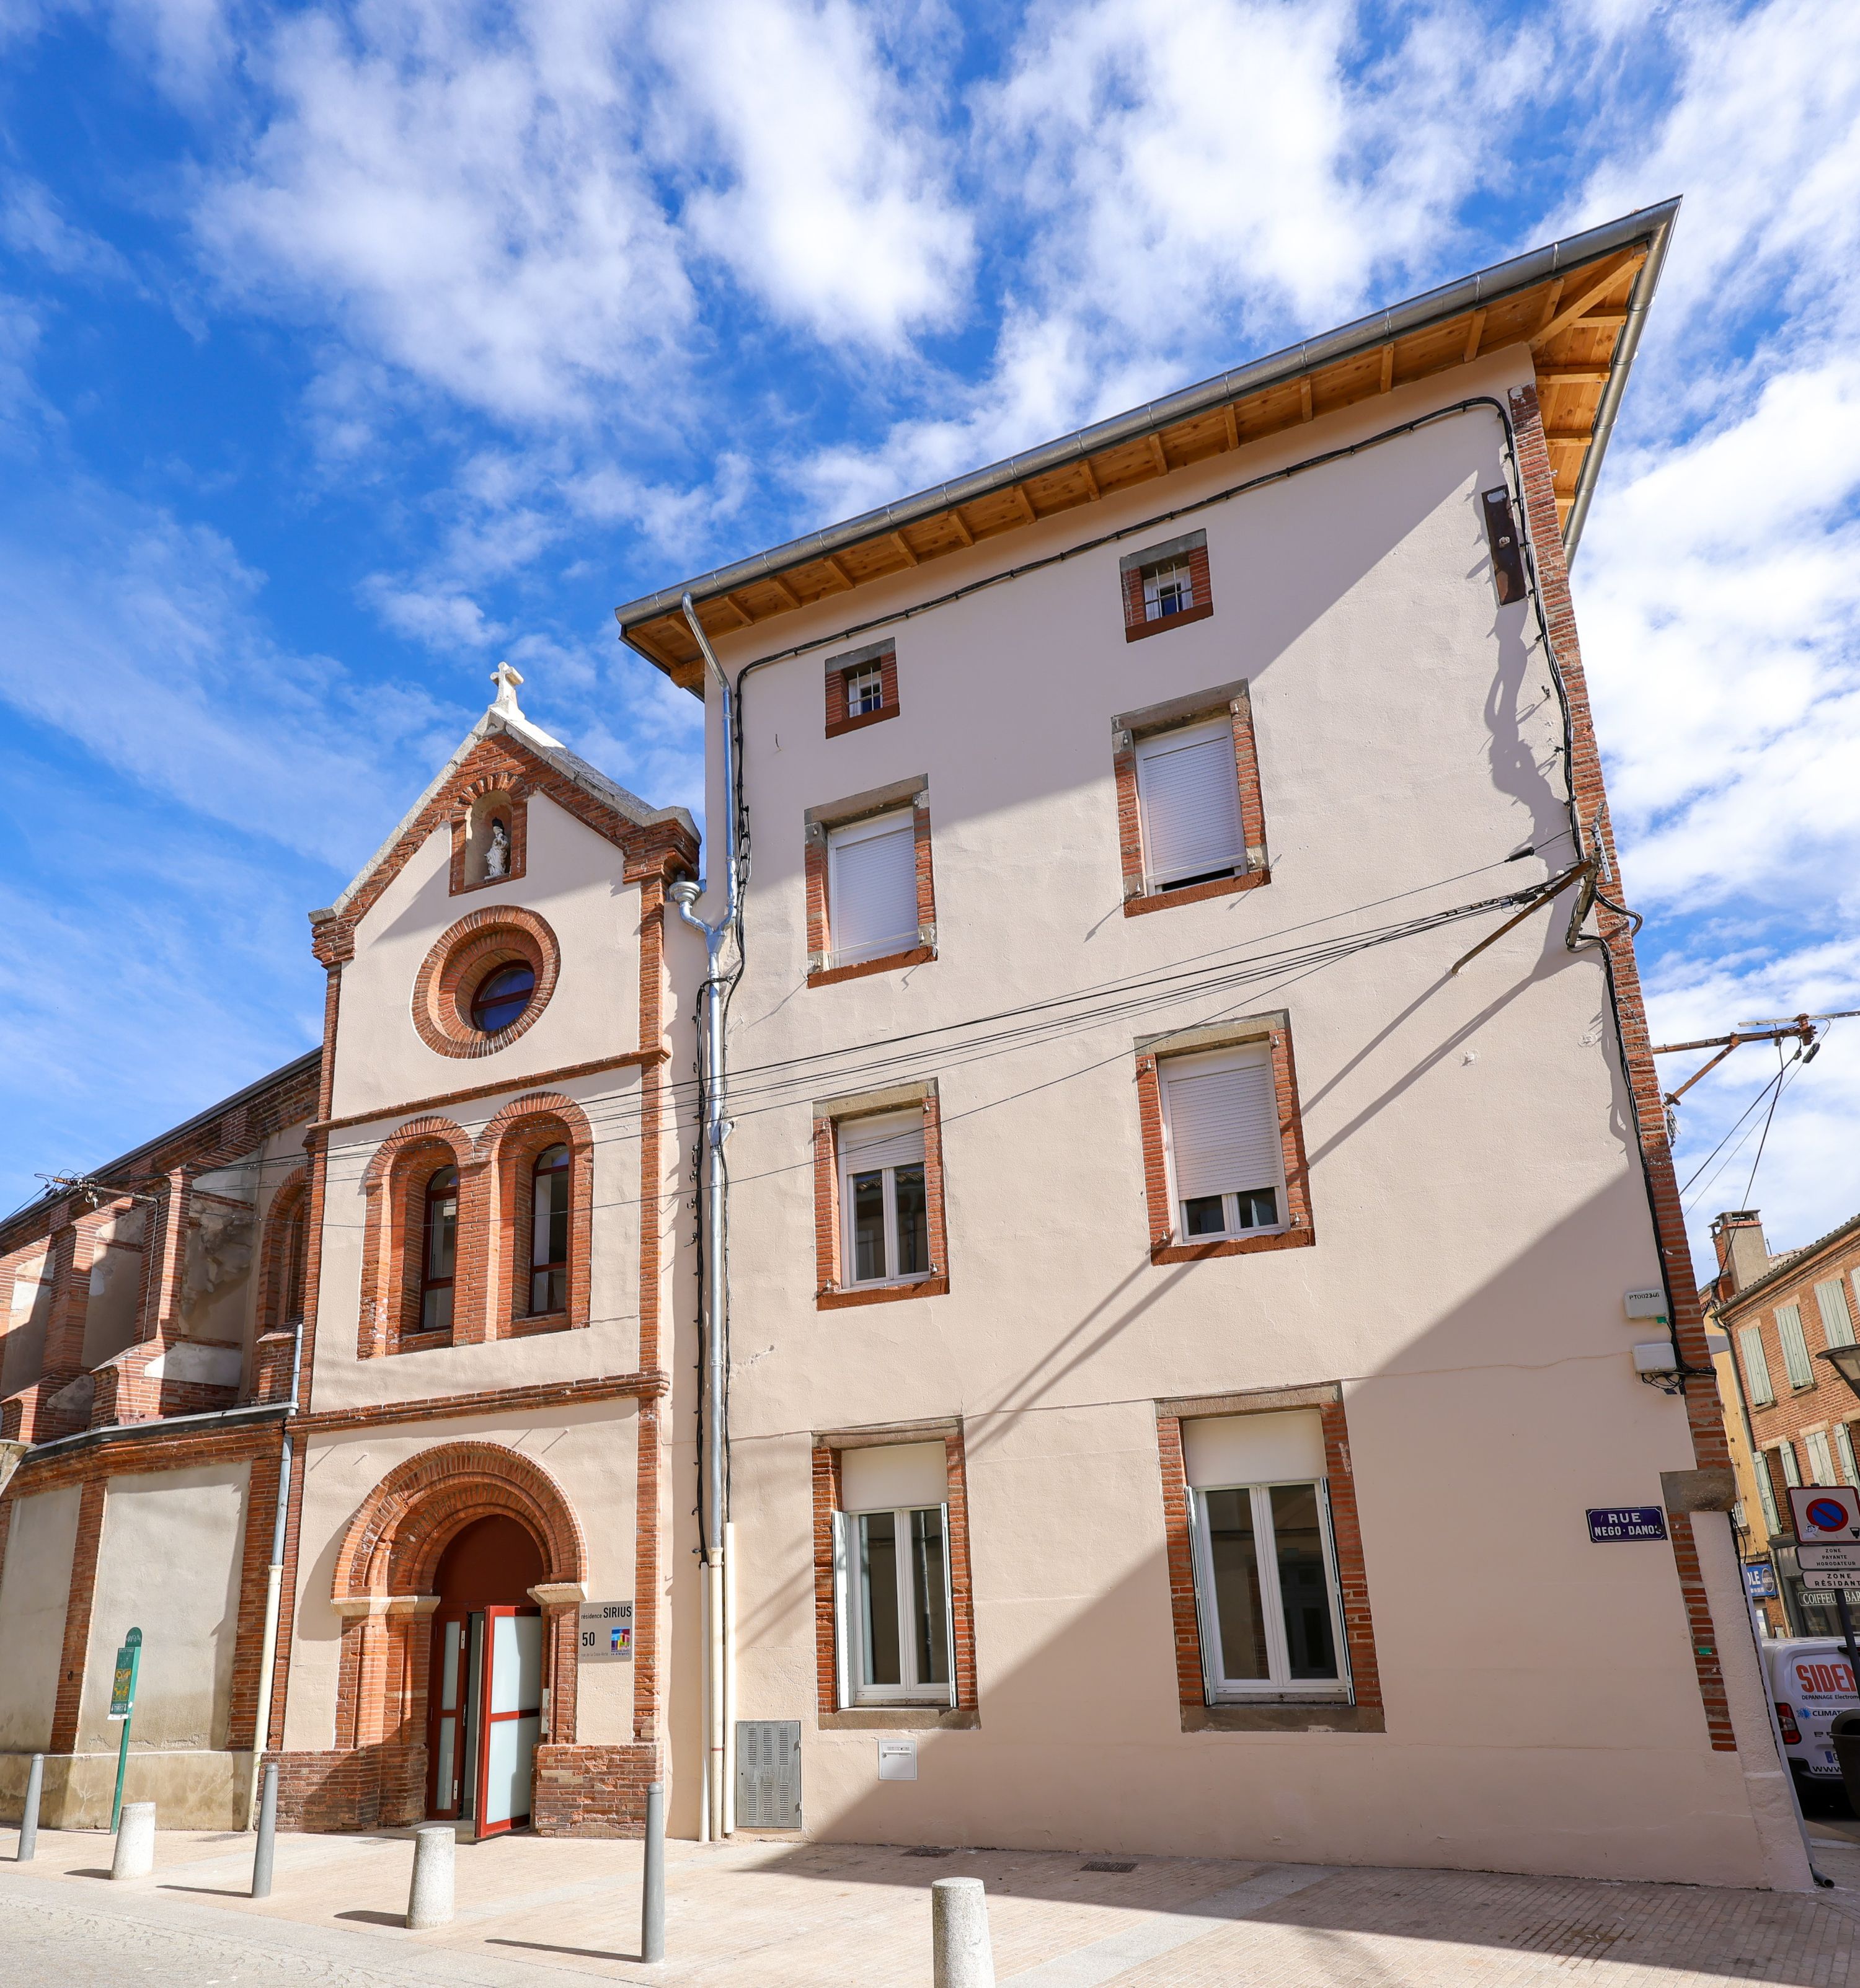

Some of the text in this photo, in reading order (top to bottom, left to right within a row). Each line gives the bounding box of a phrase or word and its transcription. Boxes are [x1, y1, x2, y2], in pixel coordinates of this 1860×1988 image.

[1608, 1512, 1641, 1524] RUE
[1594, 1526, 1621, 1536] NEGO
[1802, 1593, 1836, 1604] COIFFEU
[603, 1606, 632, 1619] SIRIUS
[582, 1632, 595, 1646] 50
